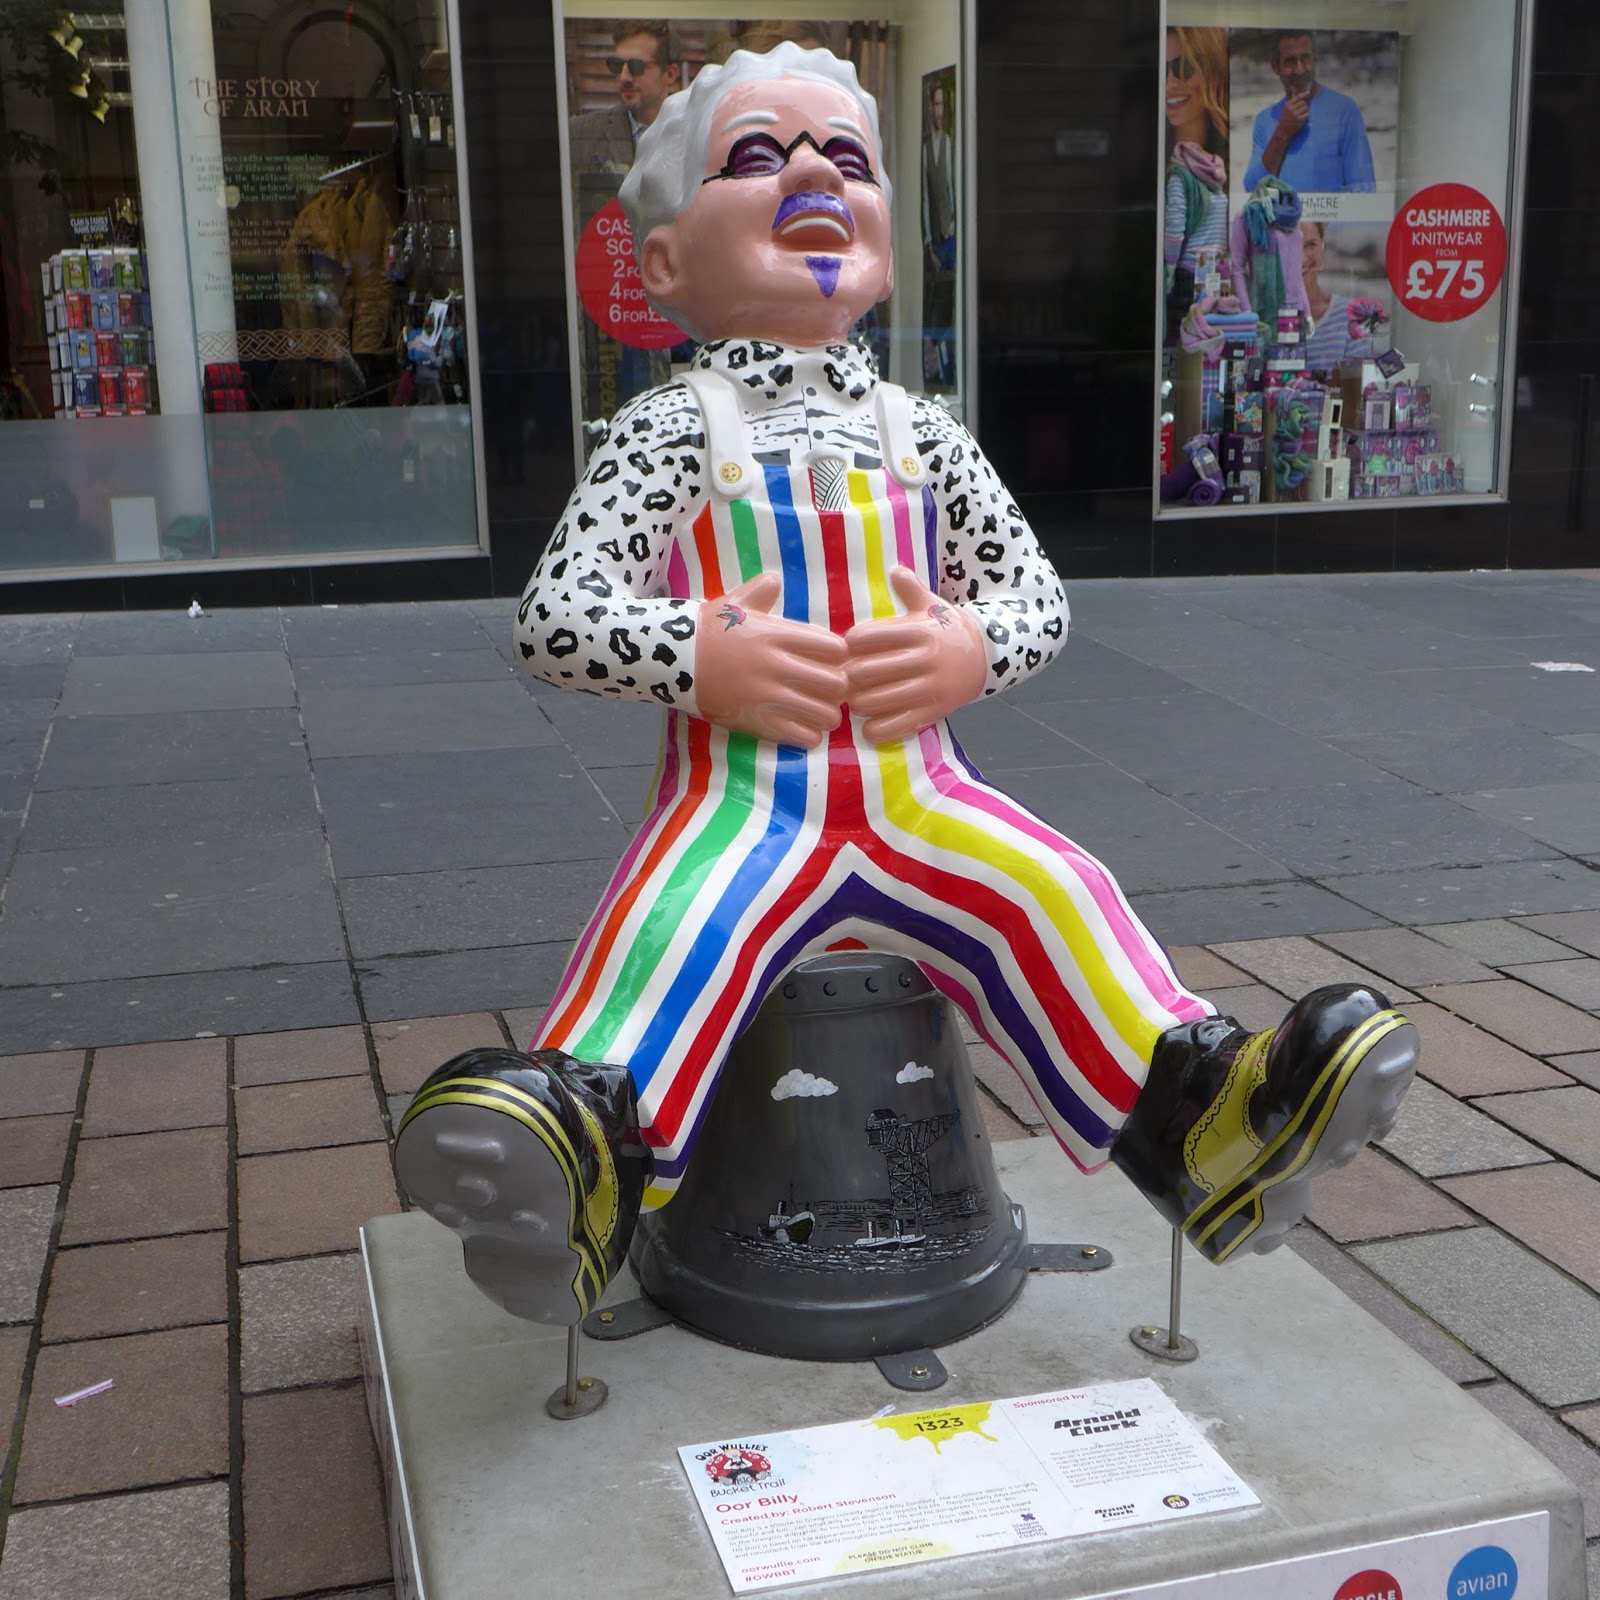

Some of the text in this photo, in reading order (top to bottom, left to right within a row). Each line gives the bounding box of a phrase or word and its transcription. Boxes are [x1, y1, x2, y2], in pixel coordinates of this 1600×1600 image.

[189, 75, 320, 99] THE STORY
[203, 99, 309, 117] OF ARAN
[1300, 196, 1339, 209] HMERE
[1406, 208, 1491, 228] CASHMERE
[1412, 231, 1483, 247] KNITWEAR
[1435, 248, 1459, 258] FROM
[1405, 258, 1486, 301] £75
[1013, 1395, 1069, 1408] Sponsored
[914, 1417, 963, 1431] 1323
[1054, 1408, 1140, 1429] Arnold
[1069, 1420, 1138, 1436] Clark
[696, 1448, 718, 1460] OOR
[710, 1478, 785, 1497] Bucket Trail
[716, 1494, 797, 1512] Oor Billy
[721, 1512, 768, 1525] Created
[792, 1503, 832, 1514] Robert
[835, 1493, 896, 1507] Stevenson
[1094, 1503, 1134, 1514] Arnold
[1102, 1509, 1133, 1518] Clark
[741, 1557, 820, 1573] oorwullie.com
[745, 1569, 795, 1582] #OWBBT
[1457, 1572, 1508, 1597] avian
